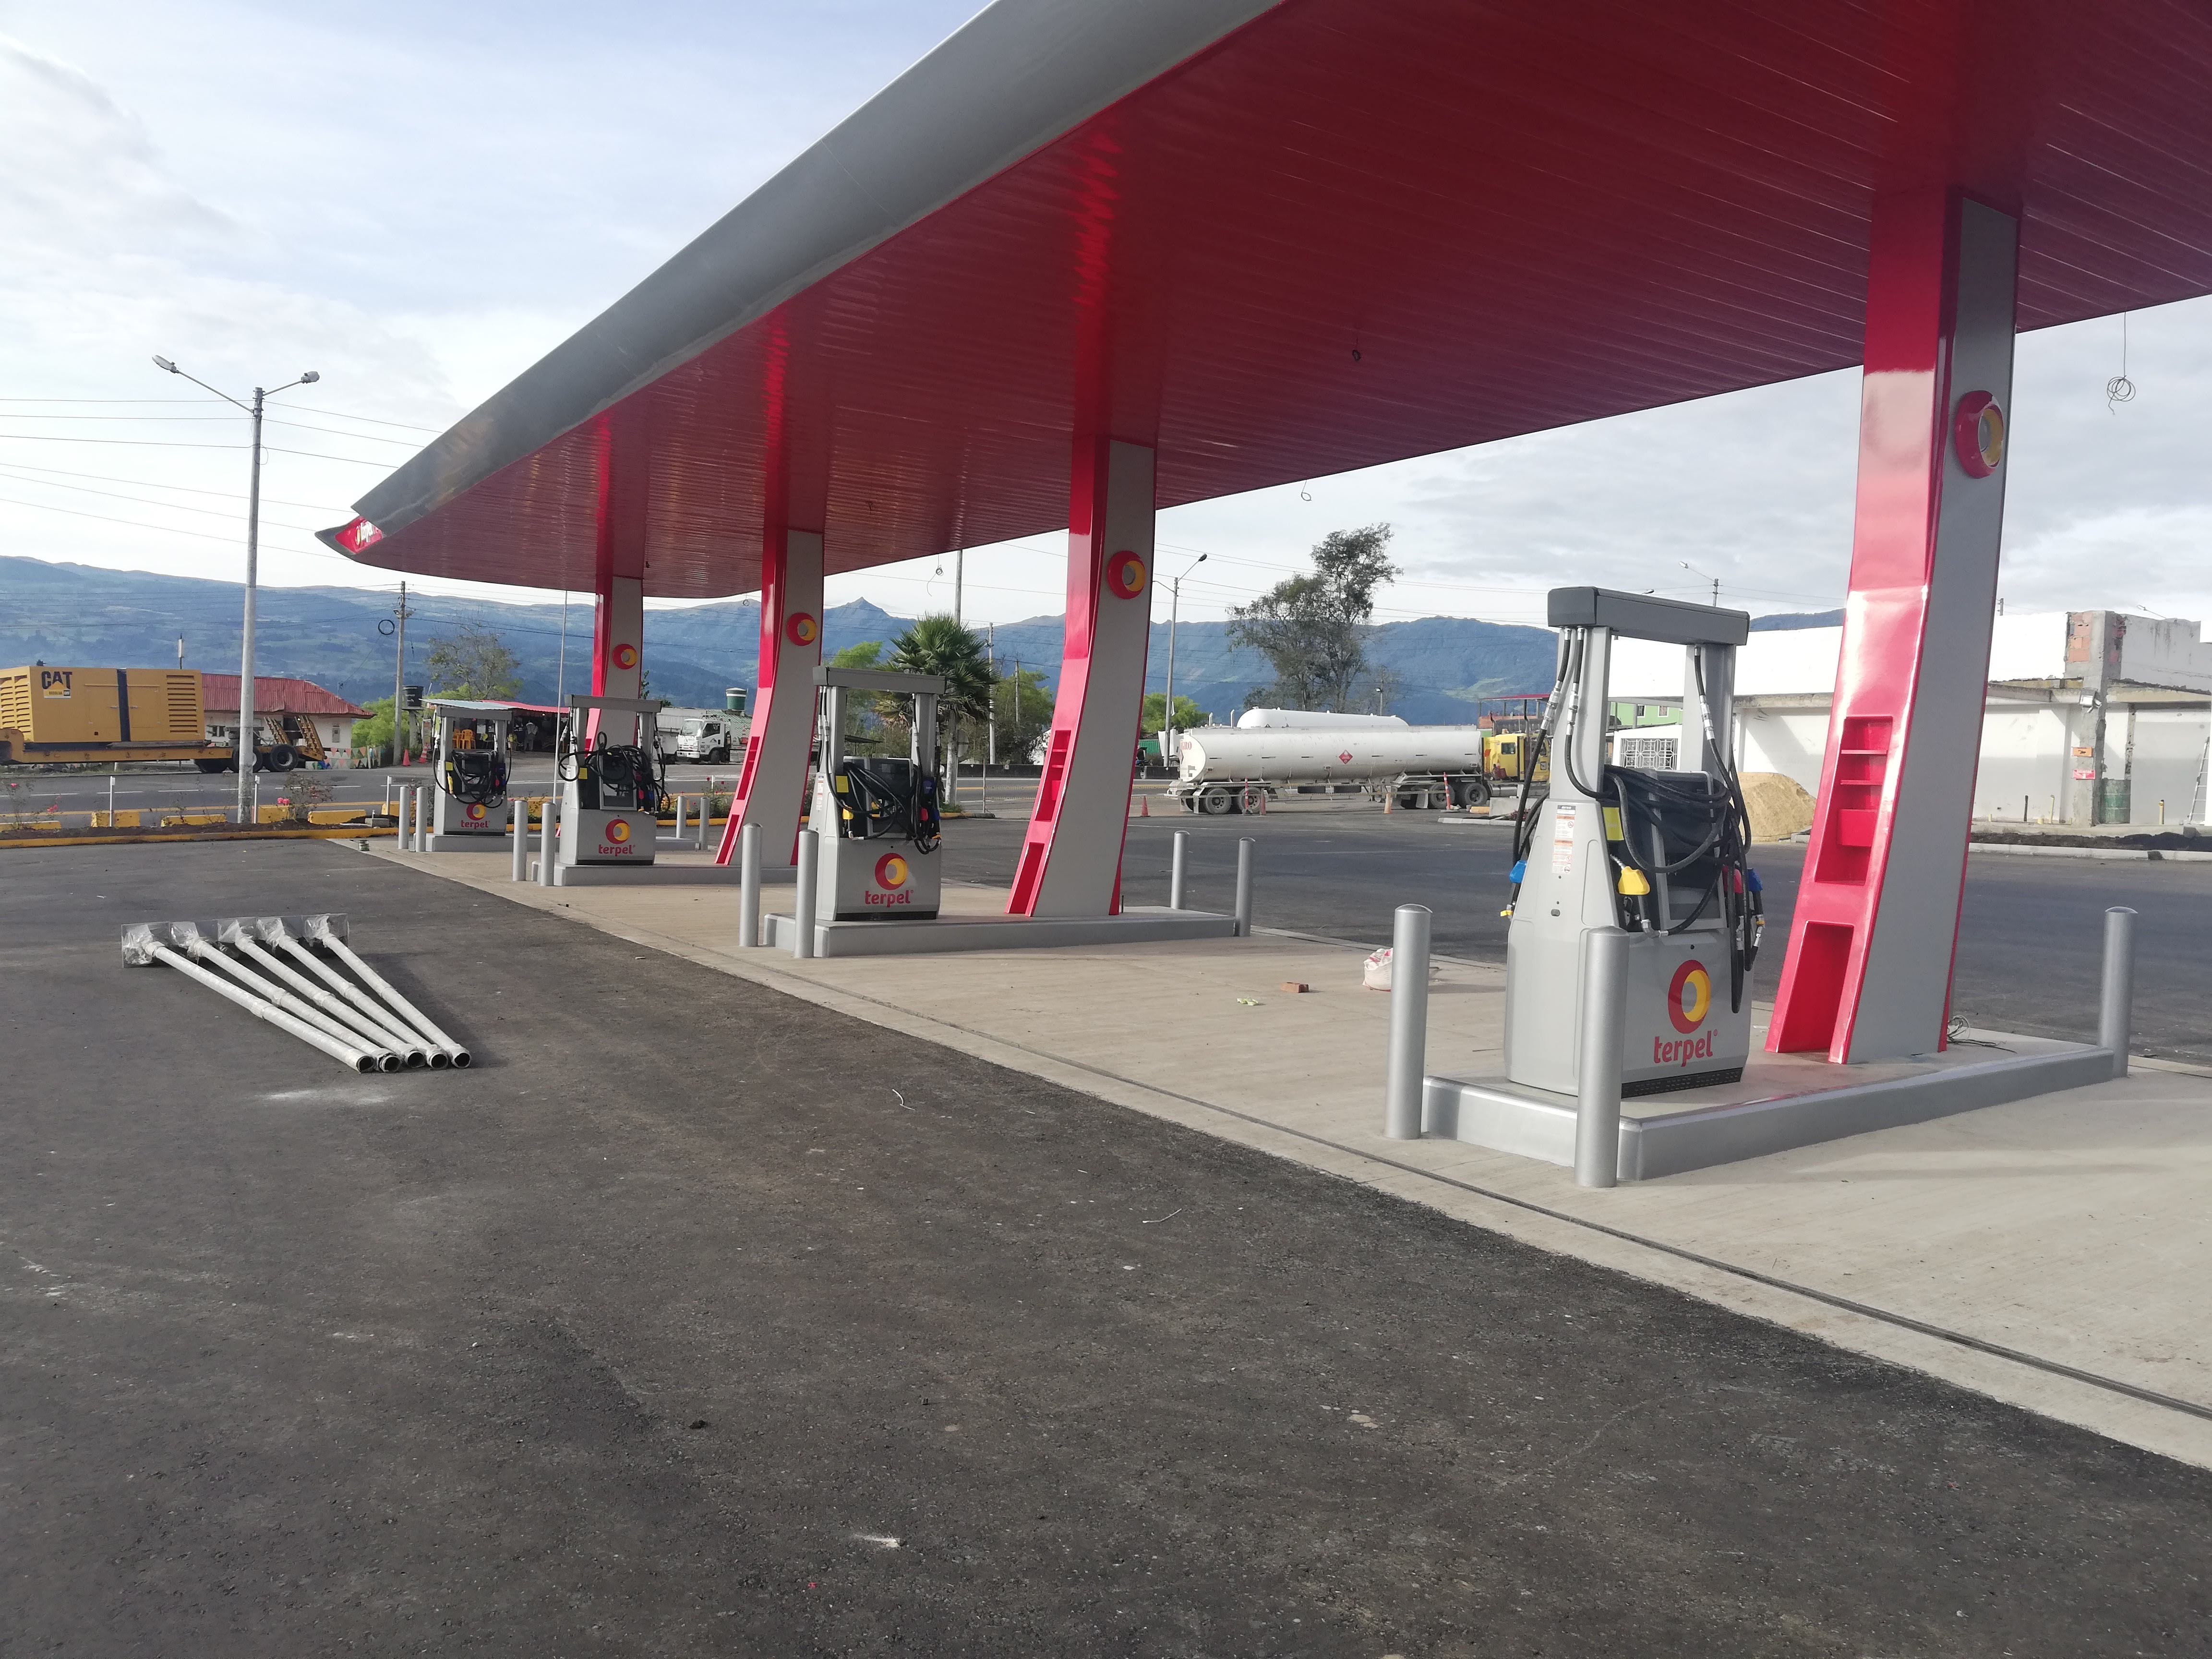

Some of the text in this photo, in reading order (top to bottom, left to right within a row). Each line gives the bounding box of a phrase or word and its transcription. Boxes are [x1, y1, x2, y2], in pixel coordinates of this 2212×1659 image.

[42, 671, 72, 689] CAT
[598, 844, 633, 856] terpel
[865, 890, 911, 908] terpel
[1654, 1030, 1713, 1067] terpel
